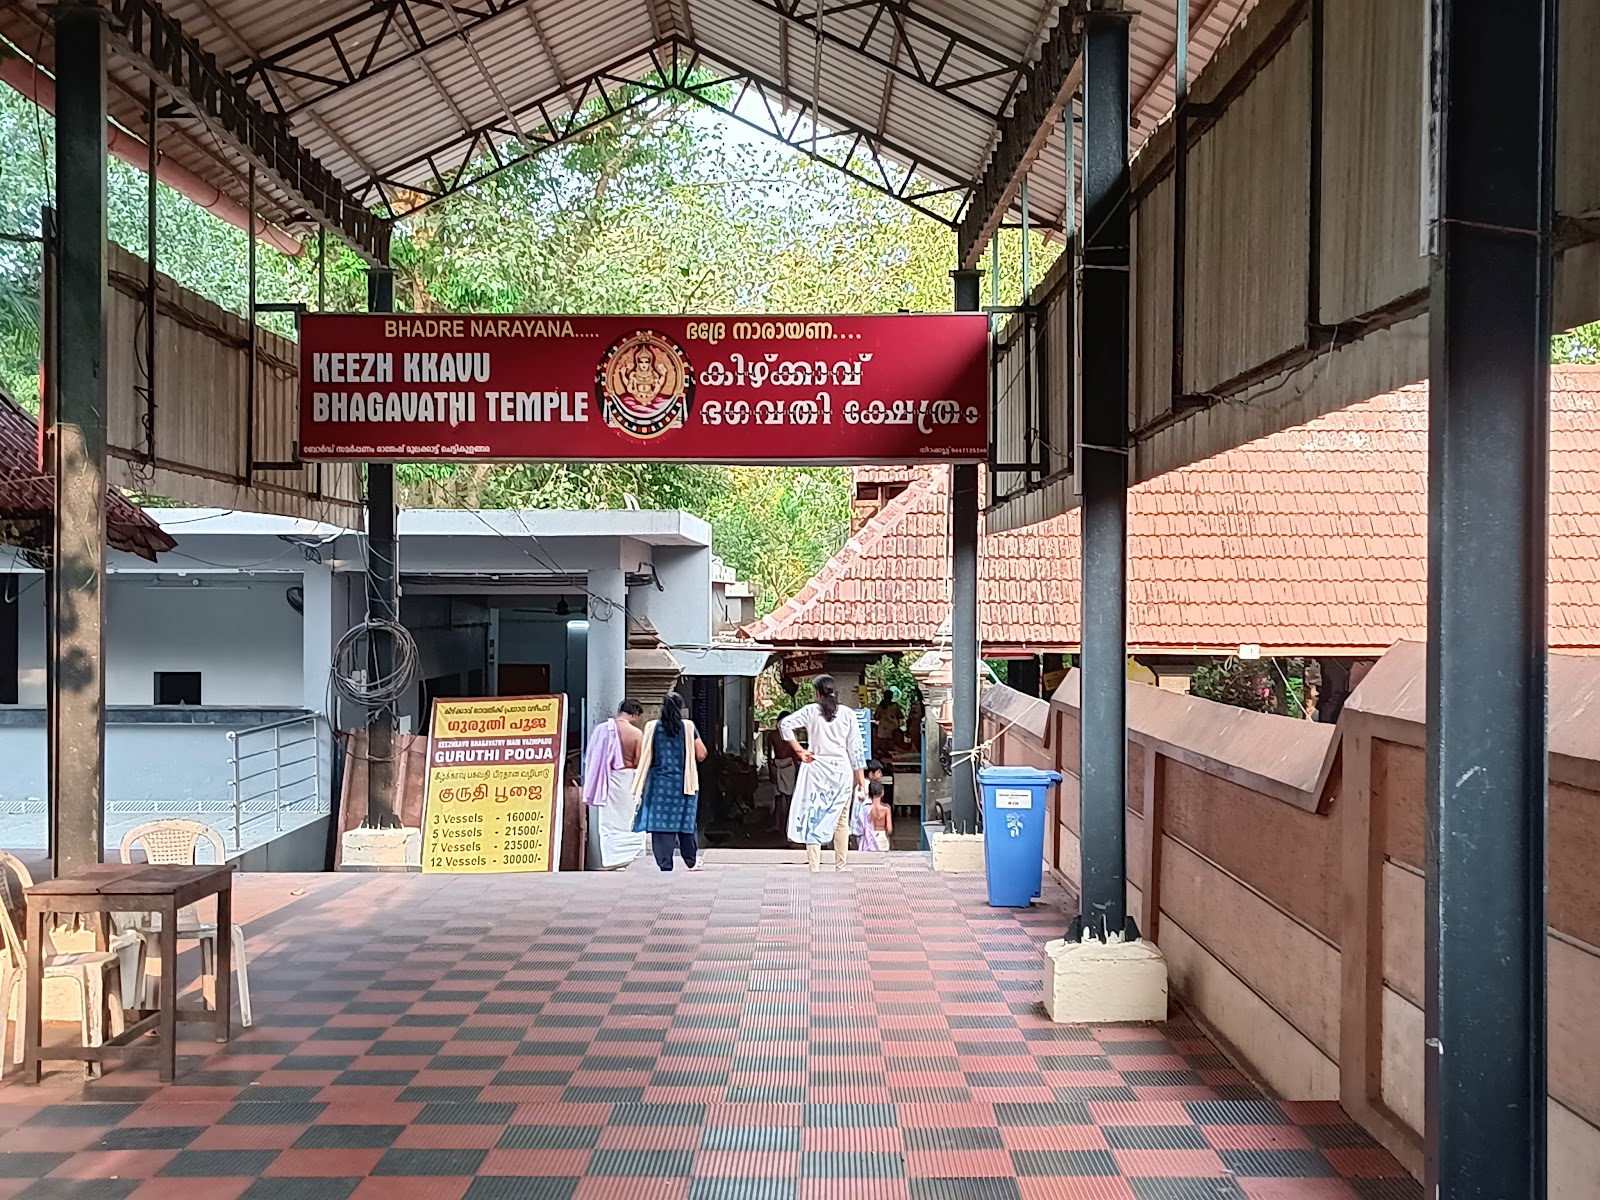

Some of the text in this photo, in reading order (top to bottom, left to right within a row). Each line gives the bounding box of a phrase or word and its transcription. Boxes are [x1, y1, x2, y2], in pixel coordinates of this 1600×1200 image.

[385, 319, 465, 338] BHADRE
[686, 322, 726, 345] ഭദ്രേ
[313, 352, 491, 383] KEEZH KKAVU
[313, 390, 589, 423] BHAGAVATHI TEMPLE
[699, 391, 979, 435] ഭഗവതി ക്ഷേത്രം
[447, 715, 547, 734] ഗുരുതി പൂജ
[434, 747, 554, 763] GURUTHI POOJA
[438, 783, 543, 803] குருதி பூஜை
[433, 815, 440, 825] 3
[443, 813, 484, 824] Vessels
[506, 811, 544, 822] 16000/-
[432, 829, 439, 839] 5
[441, 827, 483, 838] Vessels
[504, 825, 543, 836] 21500/-
[431, 843, 438, 853] 7
[440, 841, 482, 852] Vessels
[503, 840, 542, 851] 23500/-
[430, 857, 442, 868] 12
[445, 855, 487, 867] Vessels
[502, 854, 542, 865] 30000/-
